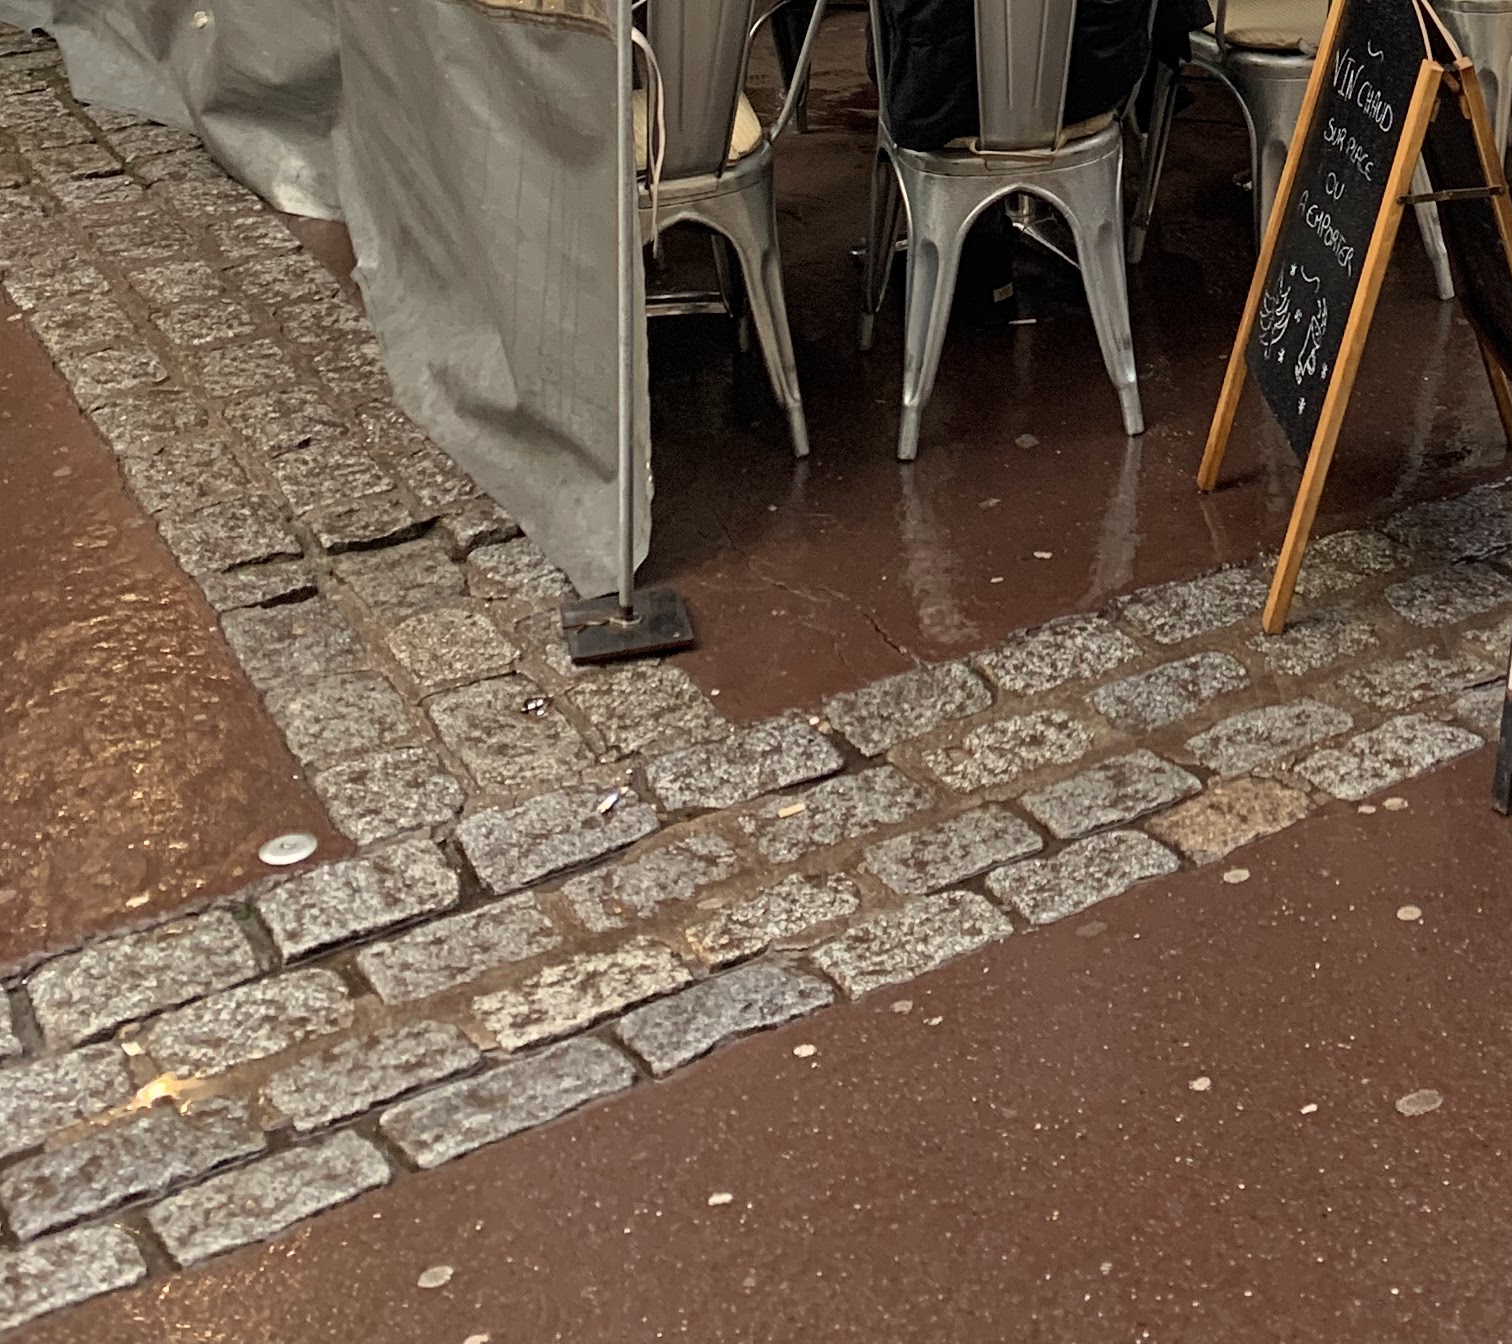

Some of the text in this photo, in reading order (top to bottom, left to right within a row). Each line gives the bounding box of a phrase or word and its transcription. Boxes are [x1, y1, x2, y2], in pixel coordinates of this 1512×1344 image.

[1333, 49, 1394, 132] VIN CHAUD
[1324, 117, 1374, 182] SUR PLACE
[1325, 172, 1345, 200] OU
[1306, 204, 1354, 277] EMPORTER
